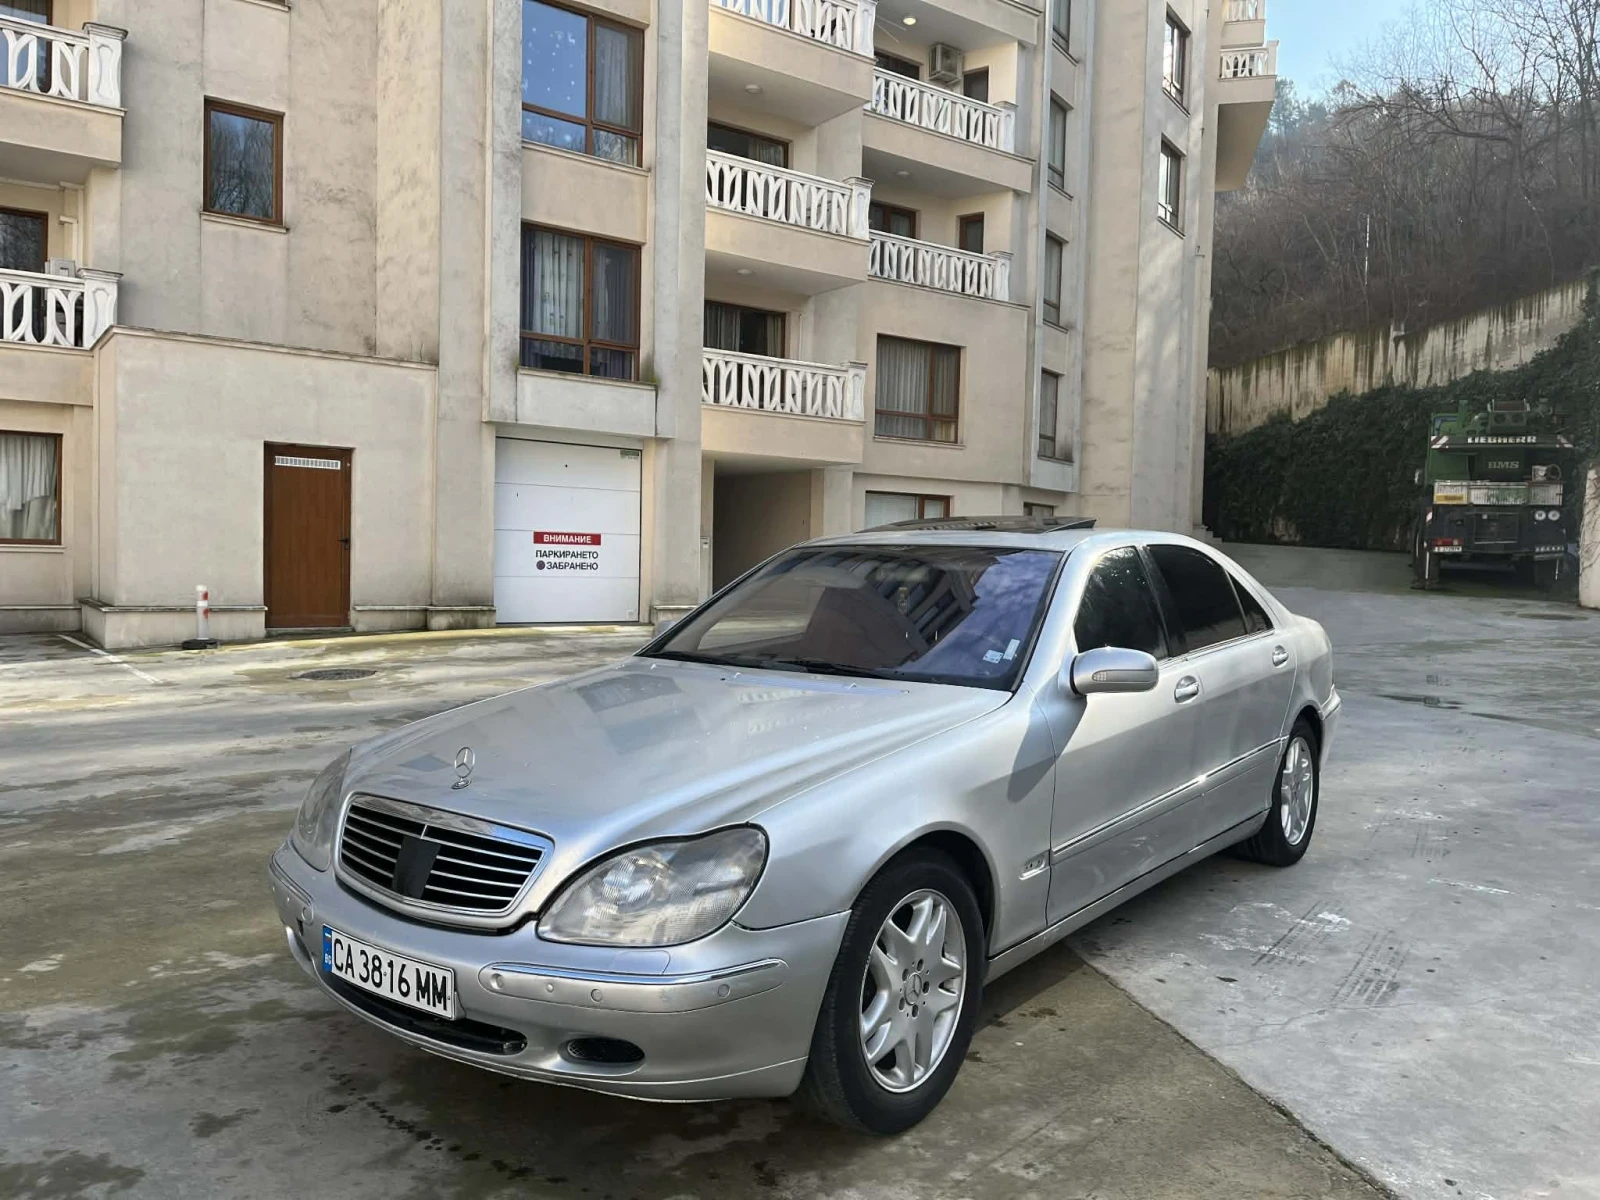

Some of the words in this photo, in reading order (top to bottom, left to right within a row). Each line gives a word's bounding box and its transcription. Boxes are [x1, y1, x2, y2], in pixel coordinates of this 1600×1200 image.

[1467, 435, 1537, 444] LIEBHERR
[543, 534, 592, 544] ВНИМАНИЕ
[535, 550, 599, 559] ПАРКИРАНЕТО
[546, 561, 599, 571] ЗАБРАНЕНО
[359, 949, 411, 998] 3816
